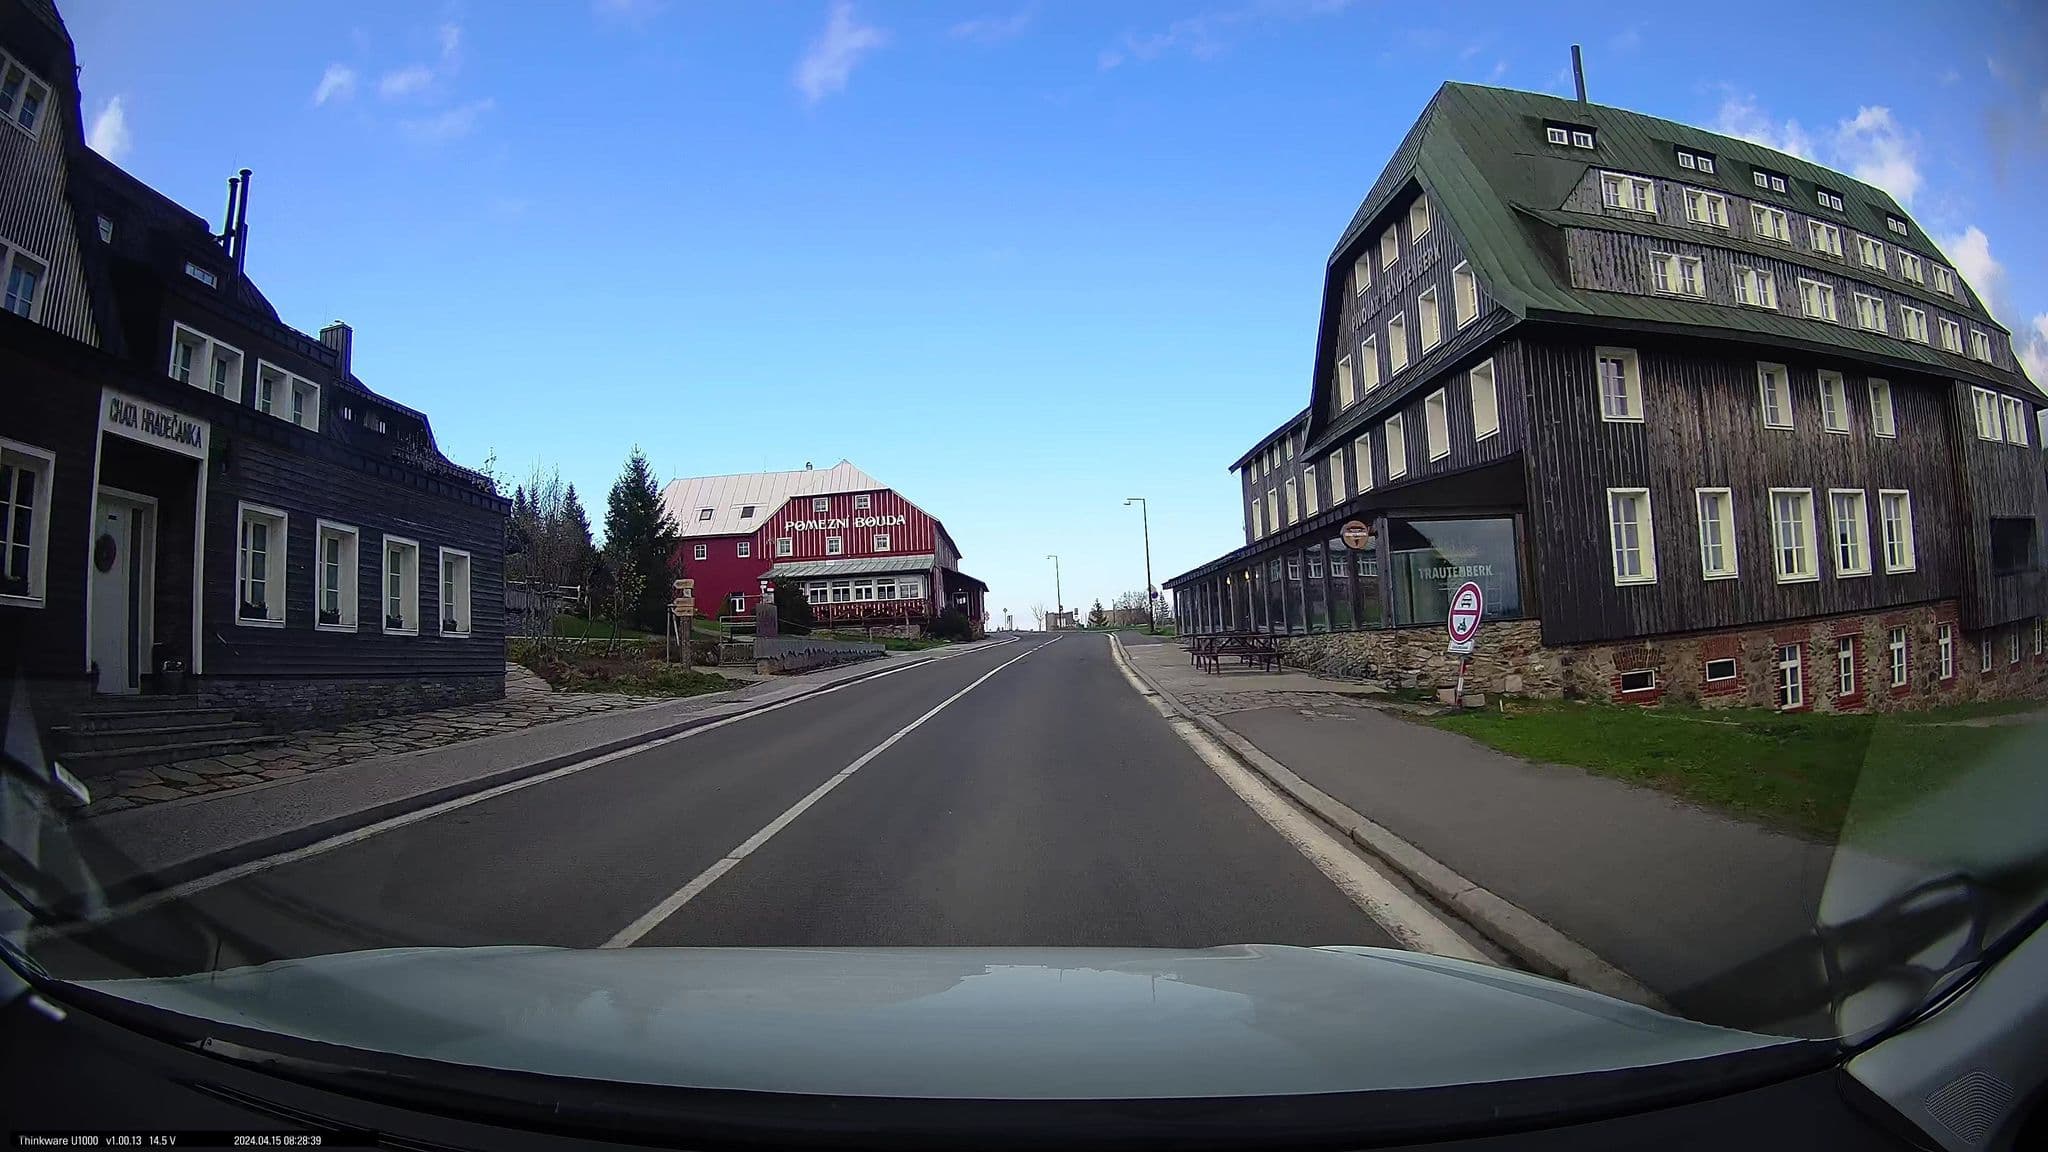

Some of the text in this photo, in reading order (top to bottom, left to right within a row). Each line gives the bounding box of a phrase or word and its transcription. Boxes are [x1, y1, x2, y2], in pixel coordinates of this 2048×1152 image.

[1381, 244, 1442, 307] TRAUTENBERK
[109, 397, 202, 449] CHATA HRADEČANKA
[855, 514, 906, 528] BOUDA
[1419, 565, 1493, 580] TRAUTENBERK
